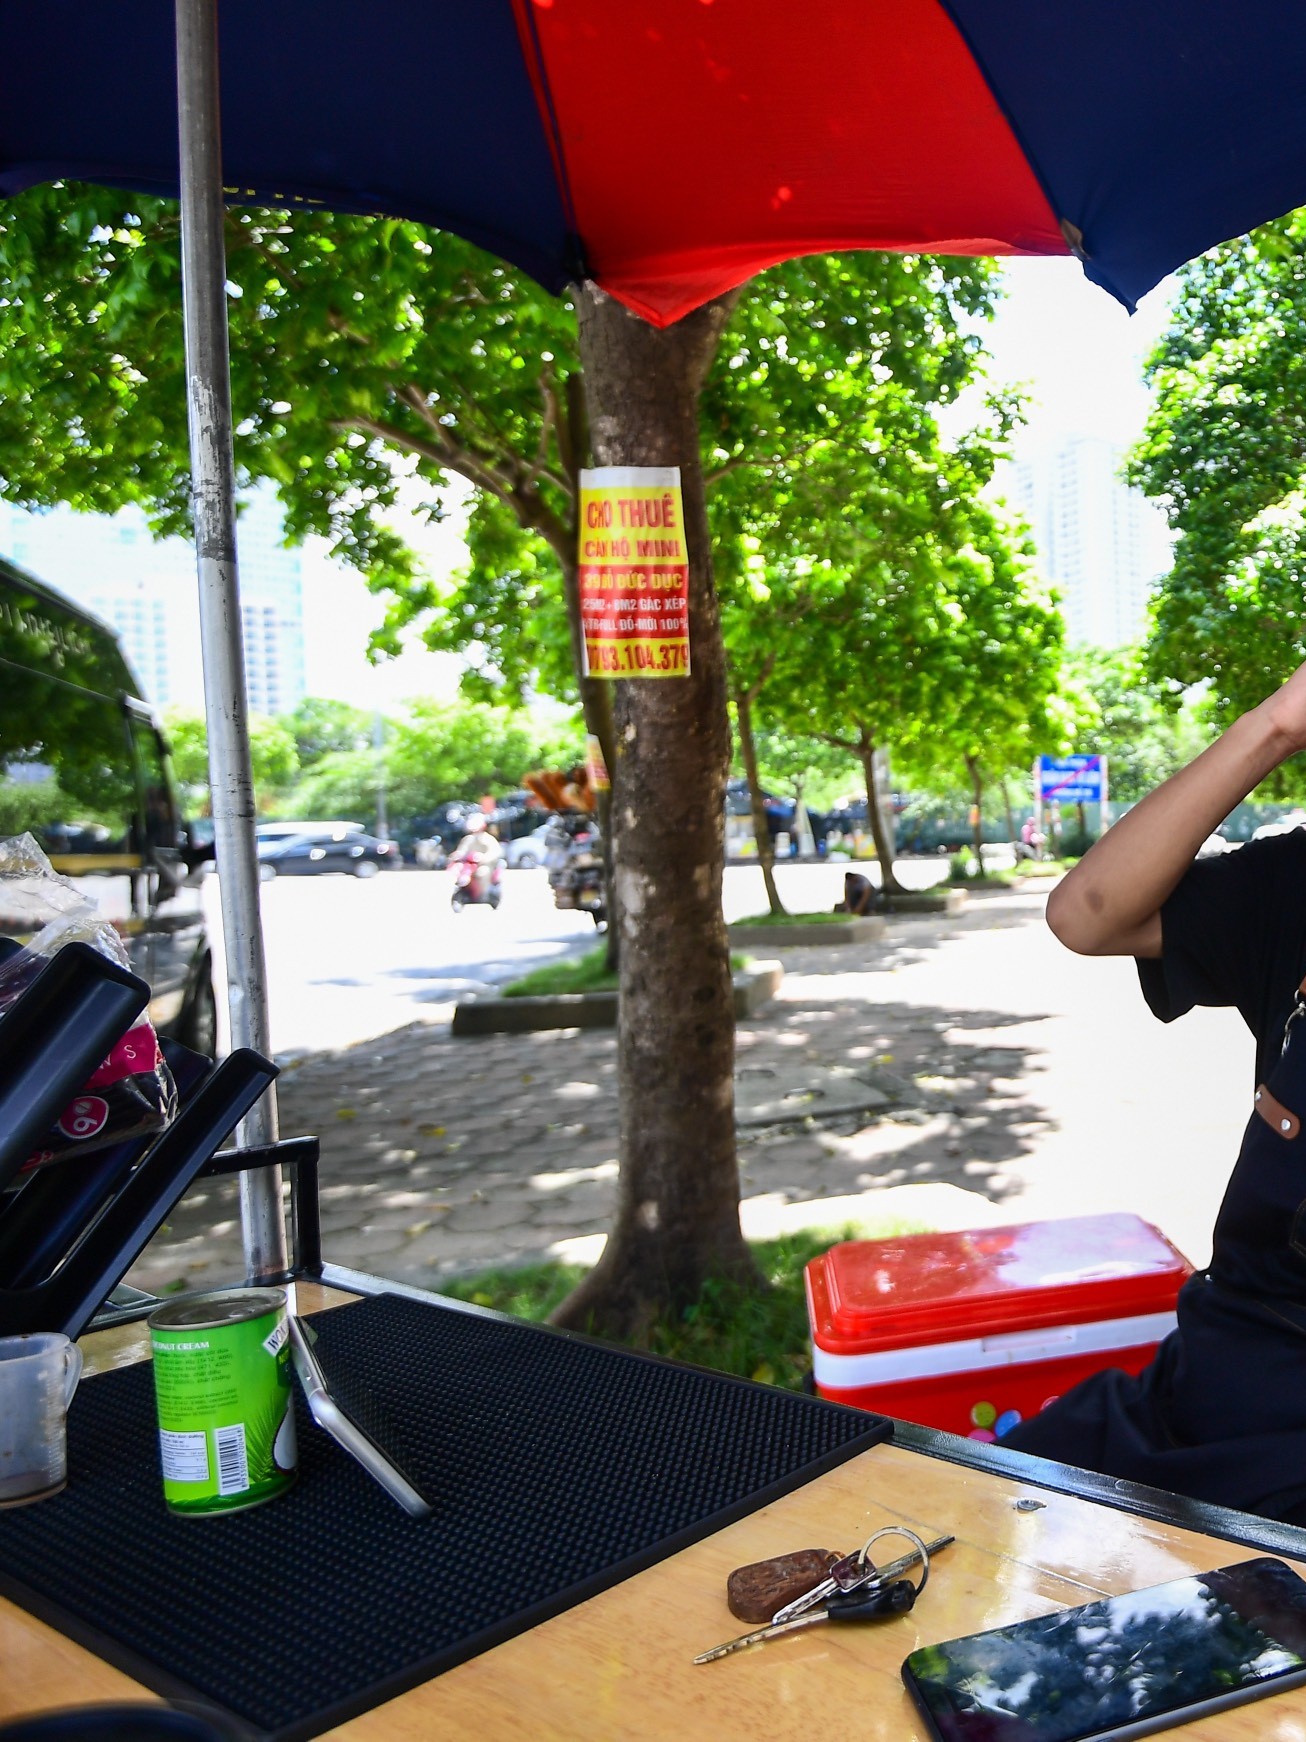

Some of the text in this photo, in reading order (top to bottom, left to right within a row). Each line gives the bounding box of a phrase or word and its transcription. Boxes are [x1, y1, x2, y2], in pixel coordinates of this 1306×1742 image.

[587, 492, 676, 529] CHO THUÊ
[612, 536, 630, 561] HỘ
[637, 540, 681, 557] MINI
[651, 573, 683, 592] DỤC
[640, 597, 662, 611] GÁC
[661, 617, 688, 630] 100%
